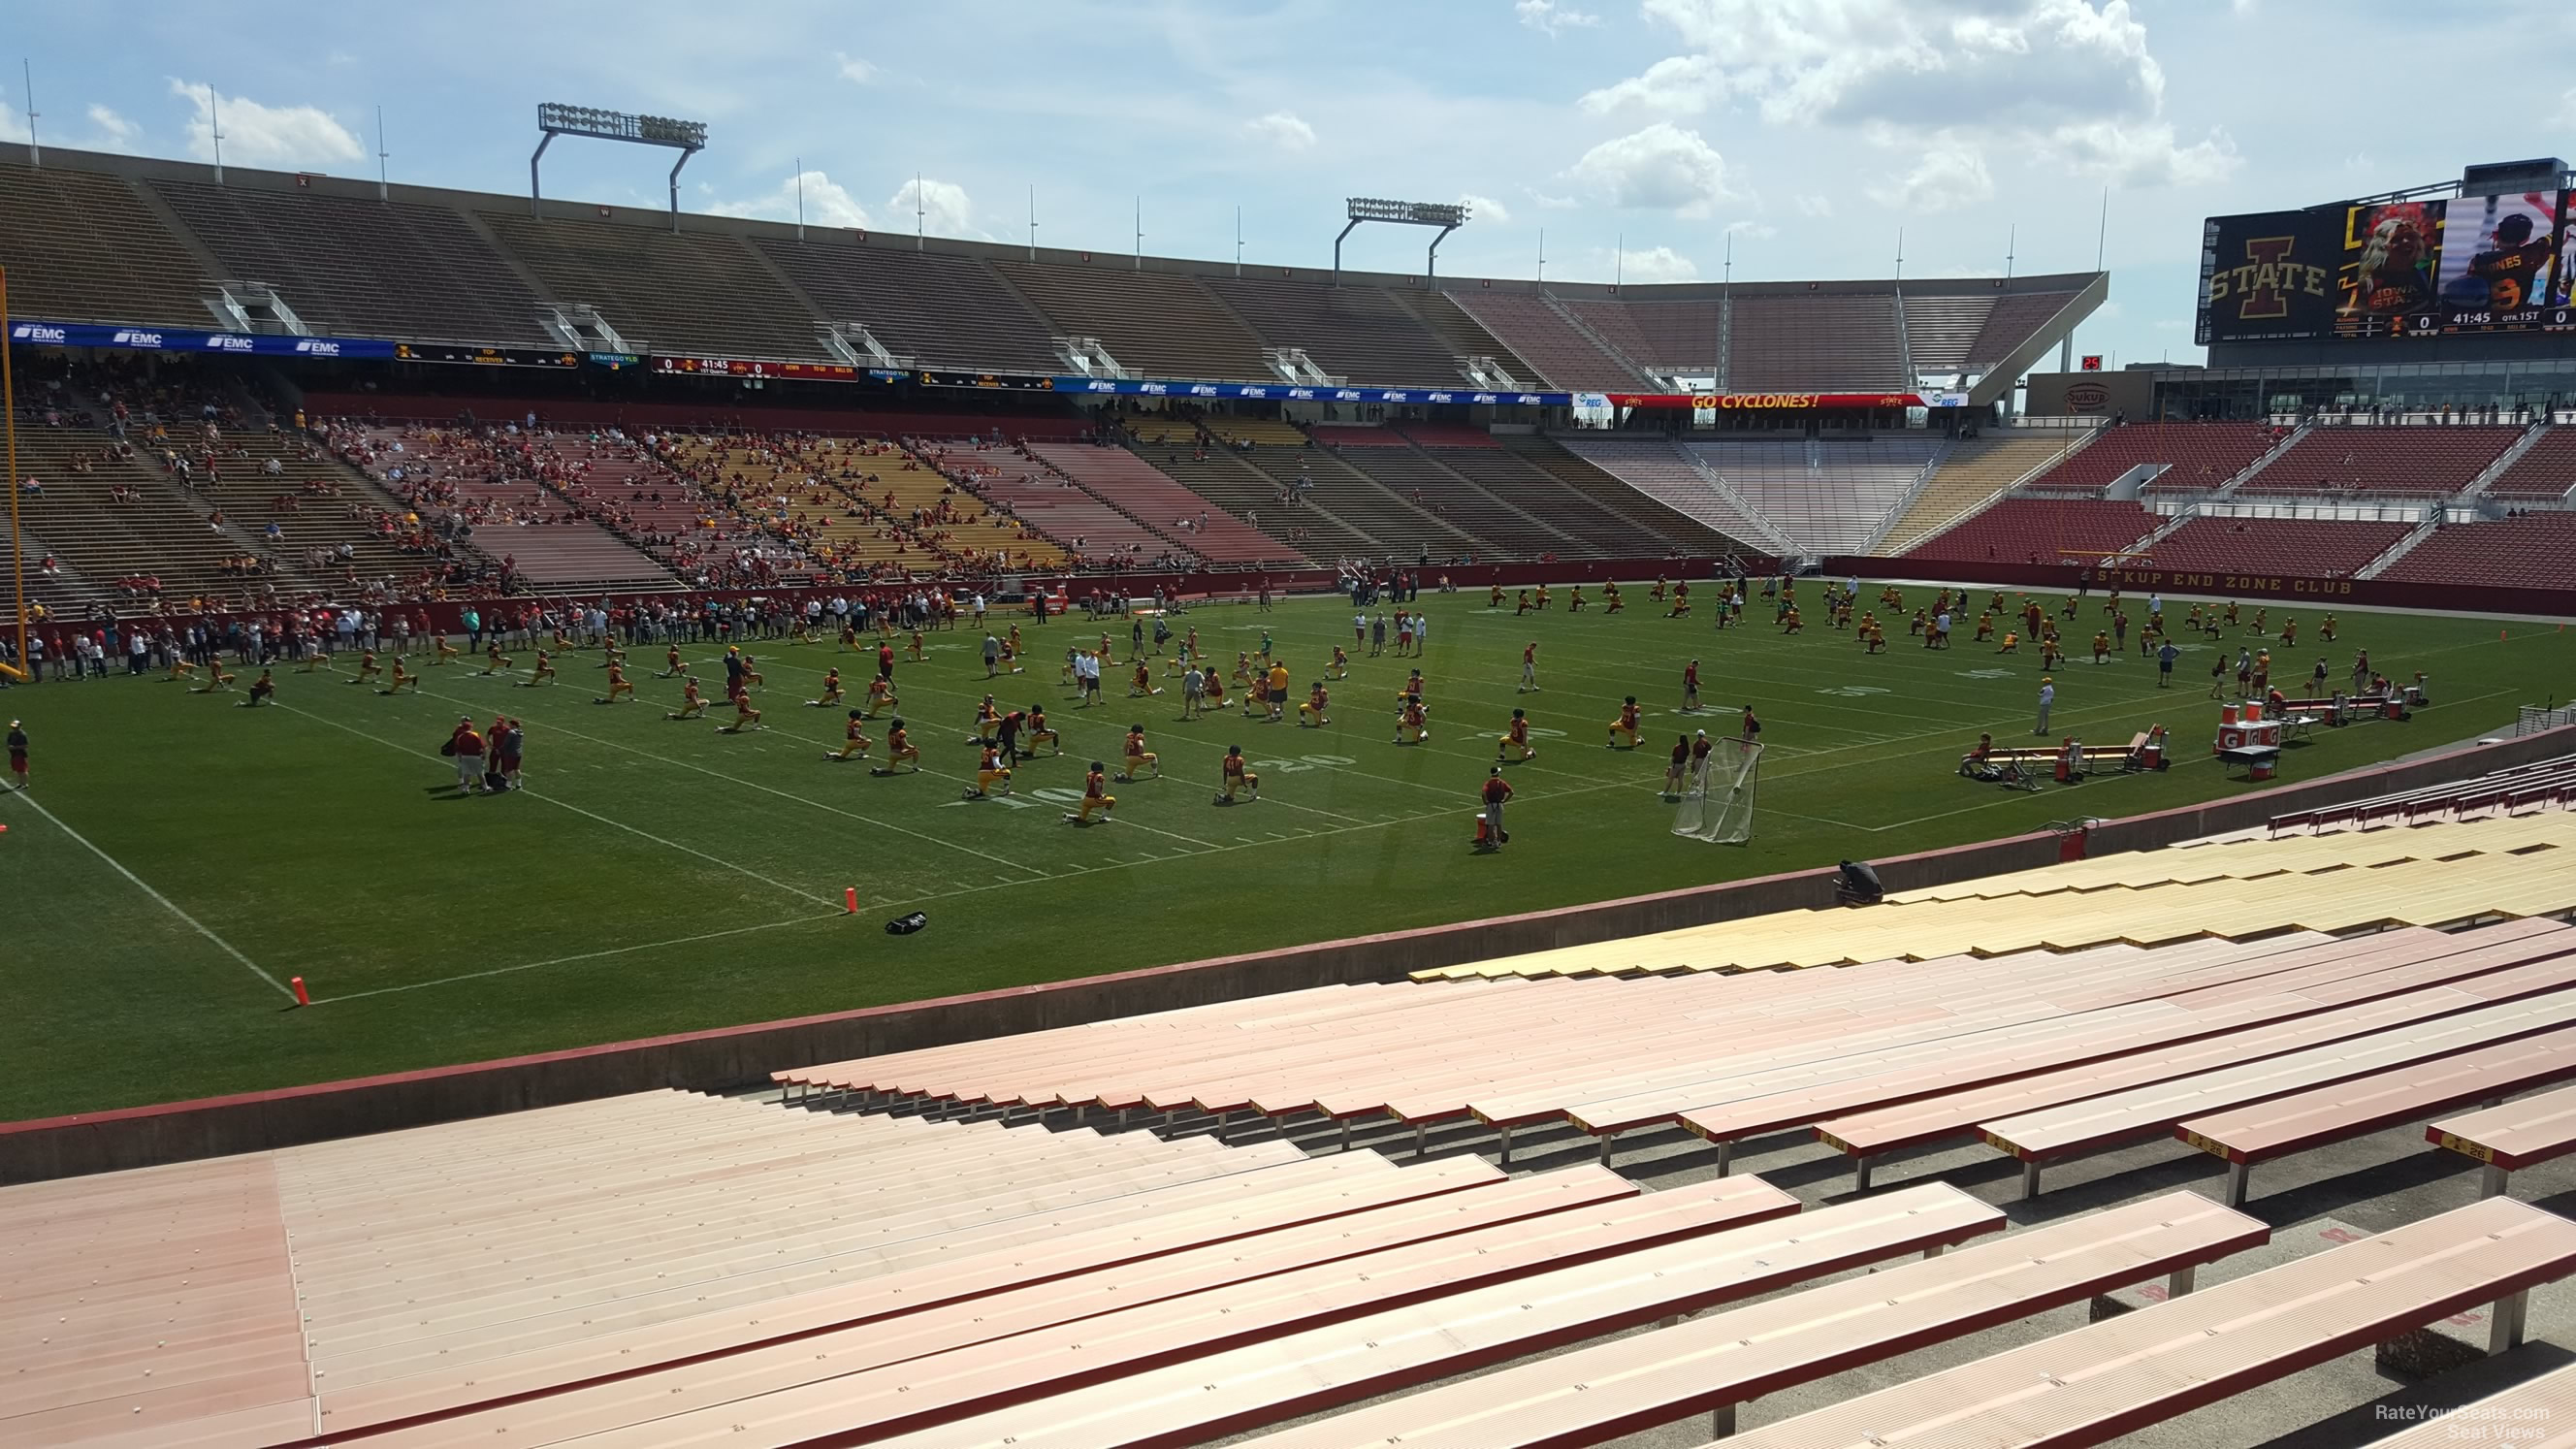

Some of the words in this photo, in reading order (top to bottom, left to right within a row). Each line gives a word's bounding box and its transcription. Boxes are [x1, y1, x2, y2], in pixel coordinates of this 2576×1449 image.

[2207, 263, 2327, 303] STATE
[2420, 317, 2430, 329] 0
[2453, 312, 2491, 324] 41:45
[2520, 311, 2539, 321] 1ST
[2556, 311, 2566, 323] 0
[32, 329, 65, 339] EMC
[131, 334, 162, 344] EMC
[223, 338, 253, 349] EMC
[311, 342, 339, 353] EMC
[664, 359, 672, 370] 0
[702, 360, 728, 370] 41:45
[755, 364, 762, 374] 0
[2083, 357, 2099, 370] 25
[1691, 395, 1716, 408] GO
[2067, 390, 2106, 402] Sukup
[1586, 399, 1601, 407] REG
[1942, 398, 1958, 407] REG
[2097, 570, 2162, 585] SKUP
[2174, 573, 2214, 587] END
[2226, 576, 2282, 591] ZONE
[2294, 580, 2352, 595] CLUB
[2224, 733, 2238, 748] G
[2250, 731, 2258, 746] G
[2270, 728, 2277, 743] G
[1252, 755, 1357, 773] 20
[2210, 1145, 2222, 1155] 25
[2469, 1147, 2485, 1159] 26
[1870, 1438, 1887, 1447] 15
